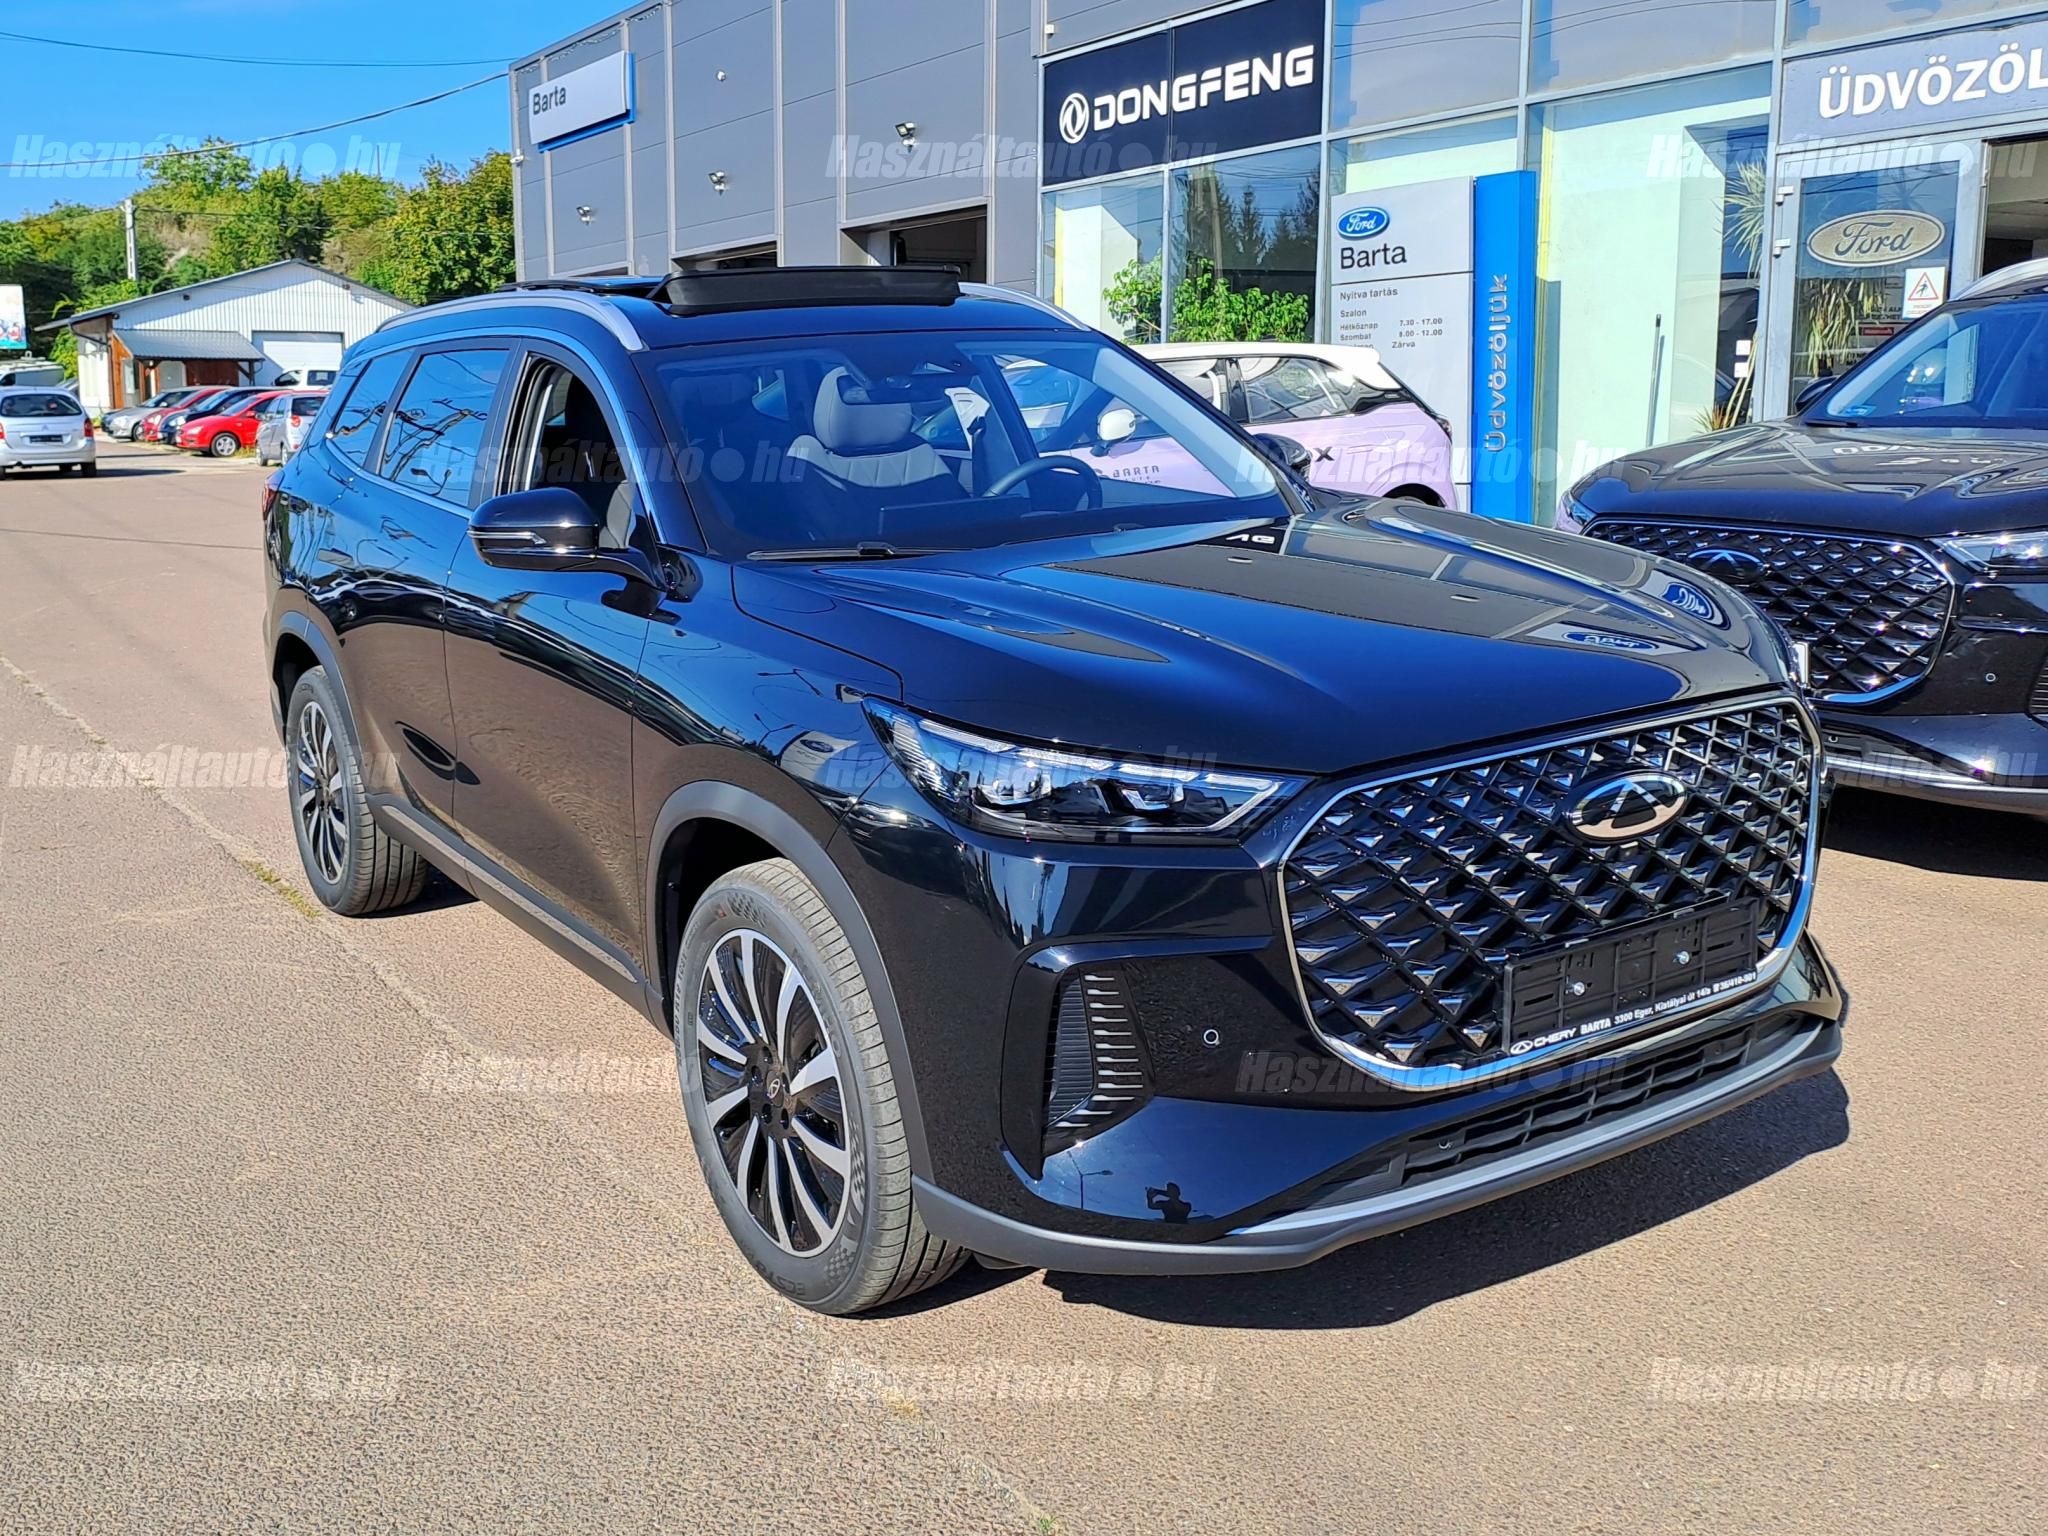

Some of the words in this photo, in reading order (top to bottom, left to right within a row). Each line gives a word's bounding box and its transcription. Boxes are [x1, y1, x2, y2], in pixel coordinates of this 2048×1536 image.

[1093, 44, 1315, 131] DONGFENG
[1819, 42, 2048, 119] ÜDVÖZÖL
[532, 85, 567, 115] Barta
[1340, 242, 1408, 269] Barta
[1340, 291, 1368, 302] Nyitva
[1369, 287, 1399, 298] tartás
[1340, 308, 1367, 318] Szalon
[1421, 317, 1443, 326] 17.00
[1340, 332, 1372, 341] Szombat
[1391, 341, 1416, 349] Zárva
[1484, 274, 1511, 452] Üdvözöljük
[1533, 1027, 1577, 1048] CHERY
[1580, 1017, 1612, 1035] BARTA
[1614, 1011, 1634, 1025] 3300
[1634, 1005, 1654, 1020] Eger,
